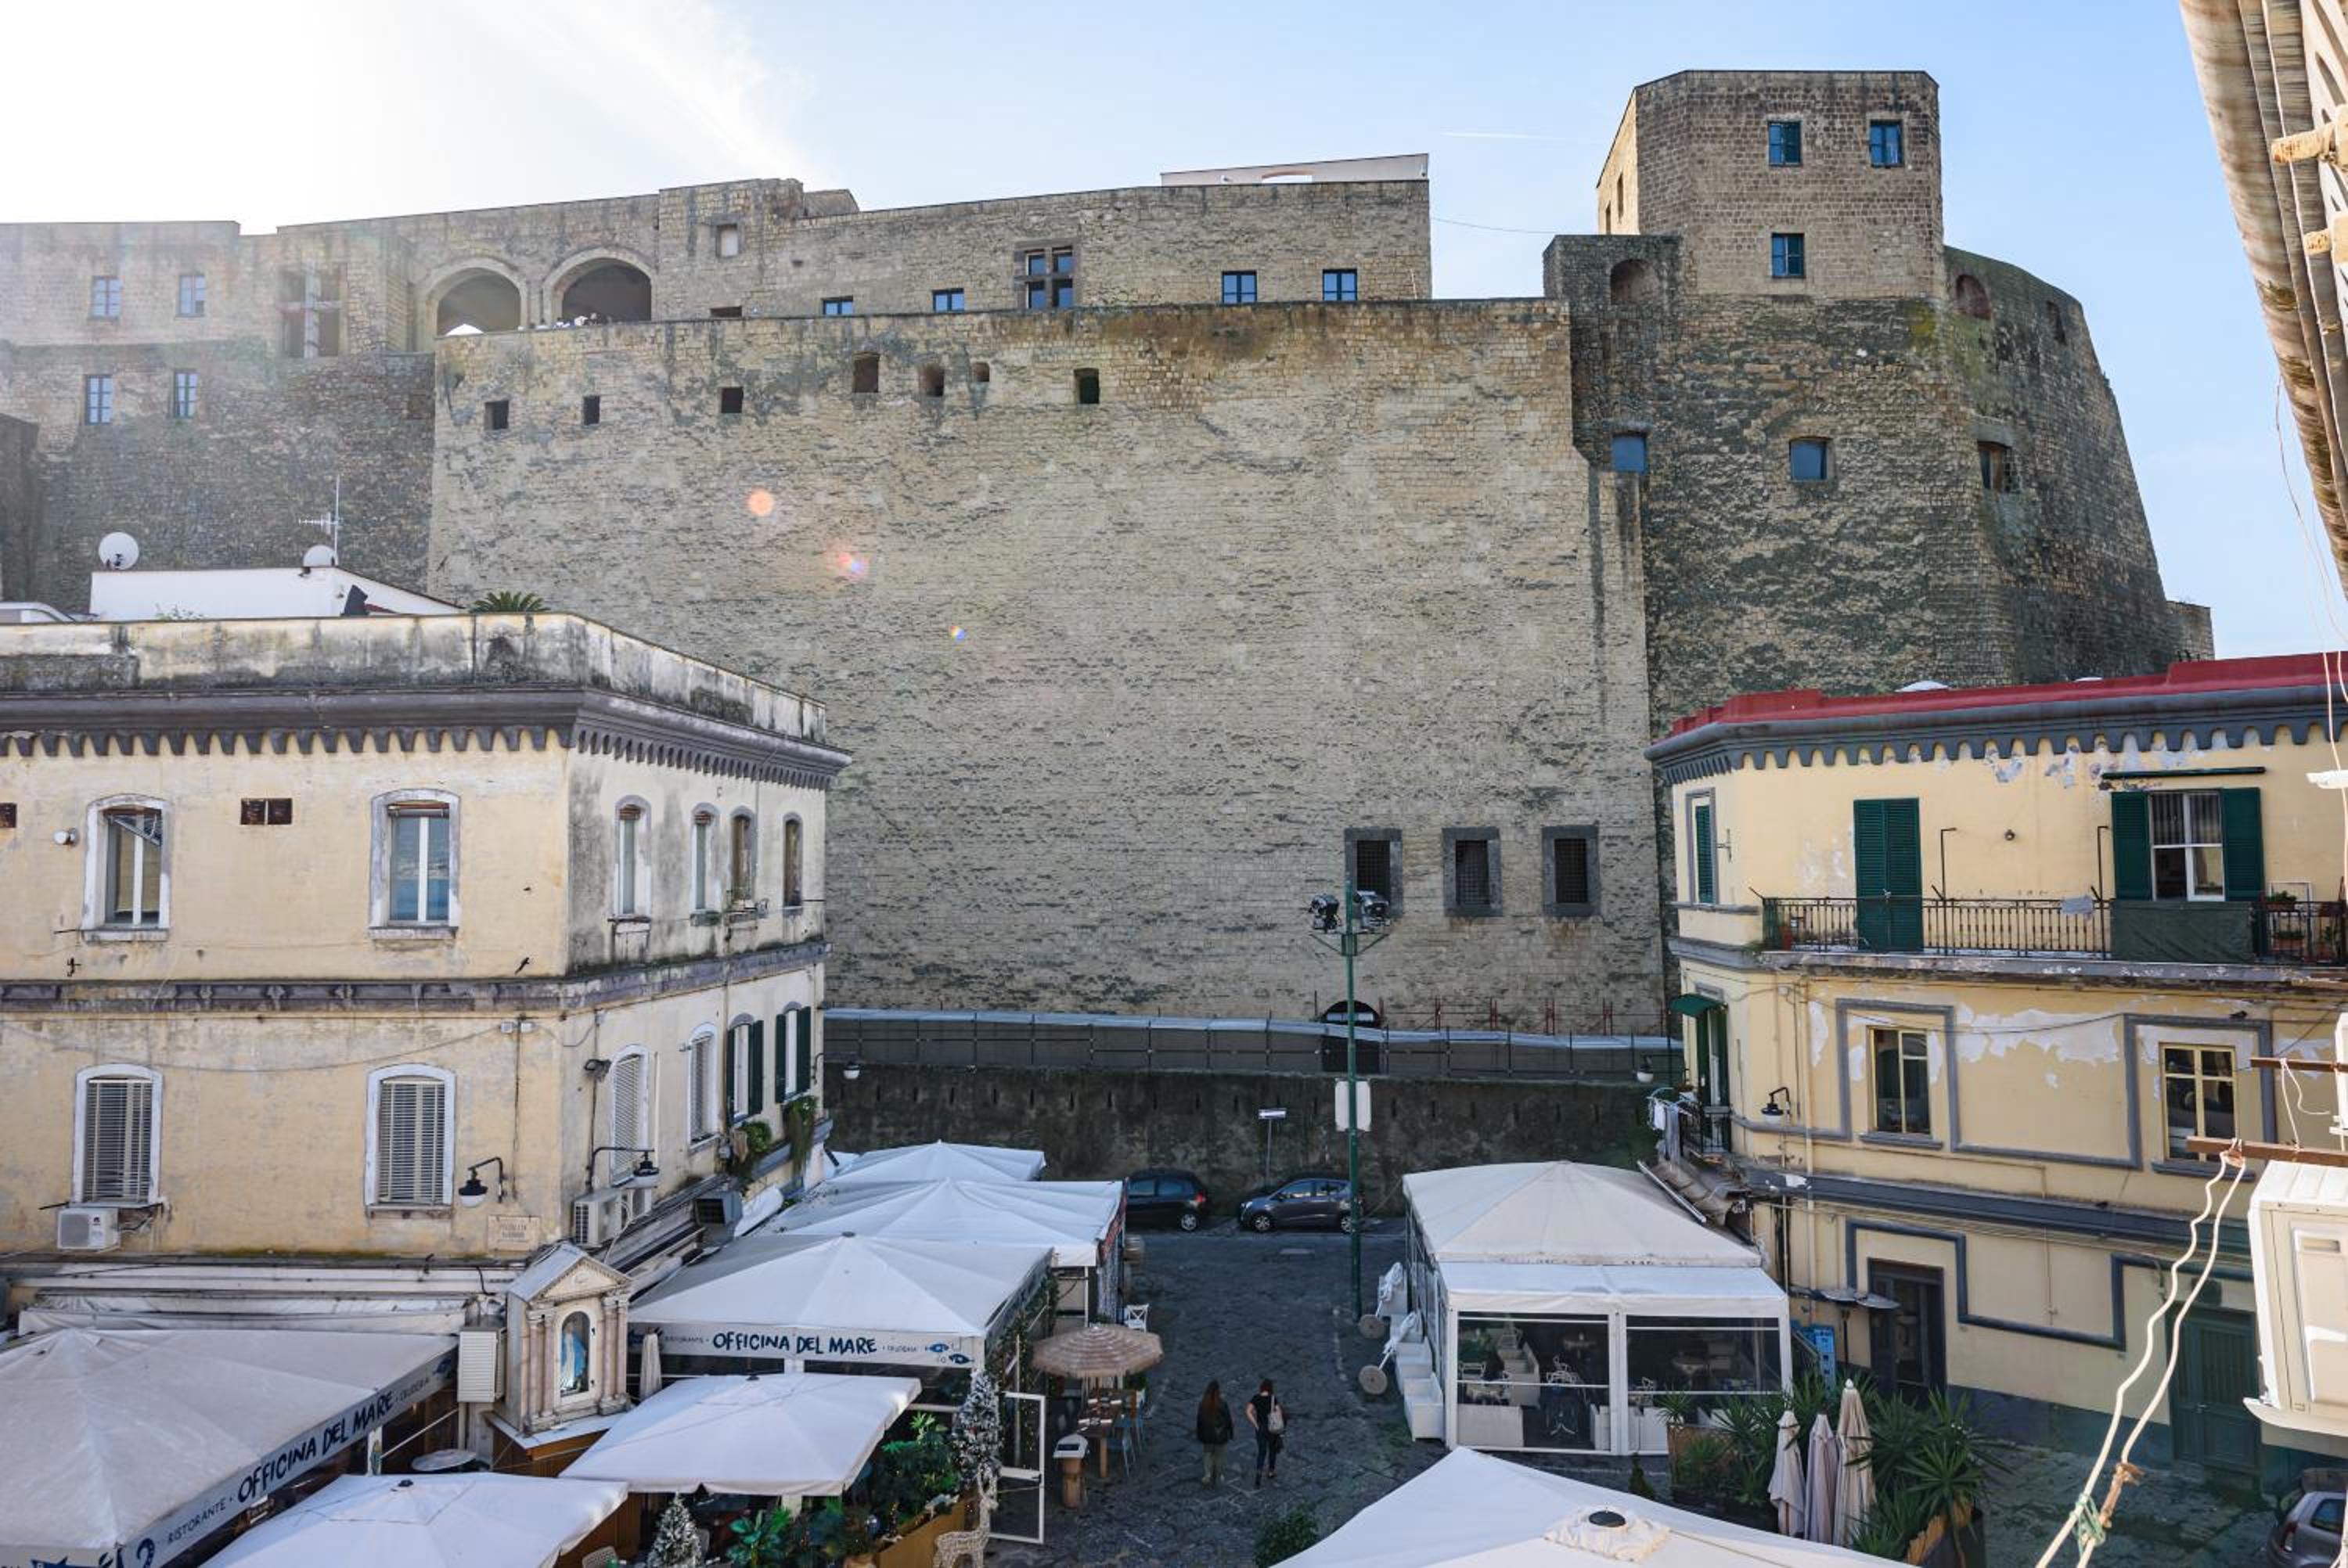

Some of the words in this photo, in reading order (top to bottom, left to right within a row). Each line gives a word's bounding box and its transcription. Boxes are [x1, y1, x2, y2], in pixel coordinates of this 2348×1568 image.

[713, 1331, 790, 1350] OFFICINA
[796, 1335, 825, 1354] DEL
[829, 1336, 877, 1355] MARE
[167, 1497, 226, 1545] RISTORANTE
[237, 1437, 317, 1503] OFFICINA
[322, 1419, 349, 1455] DEL
[352, 1390, 394, 1434] MARE
